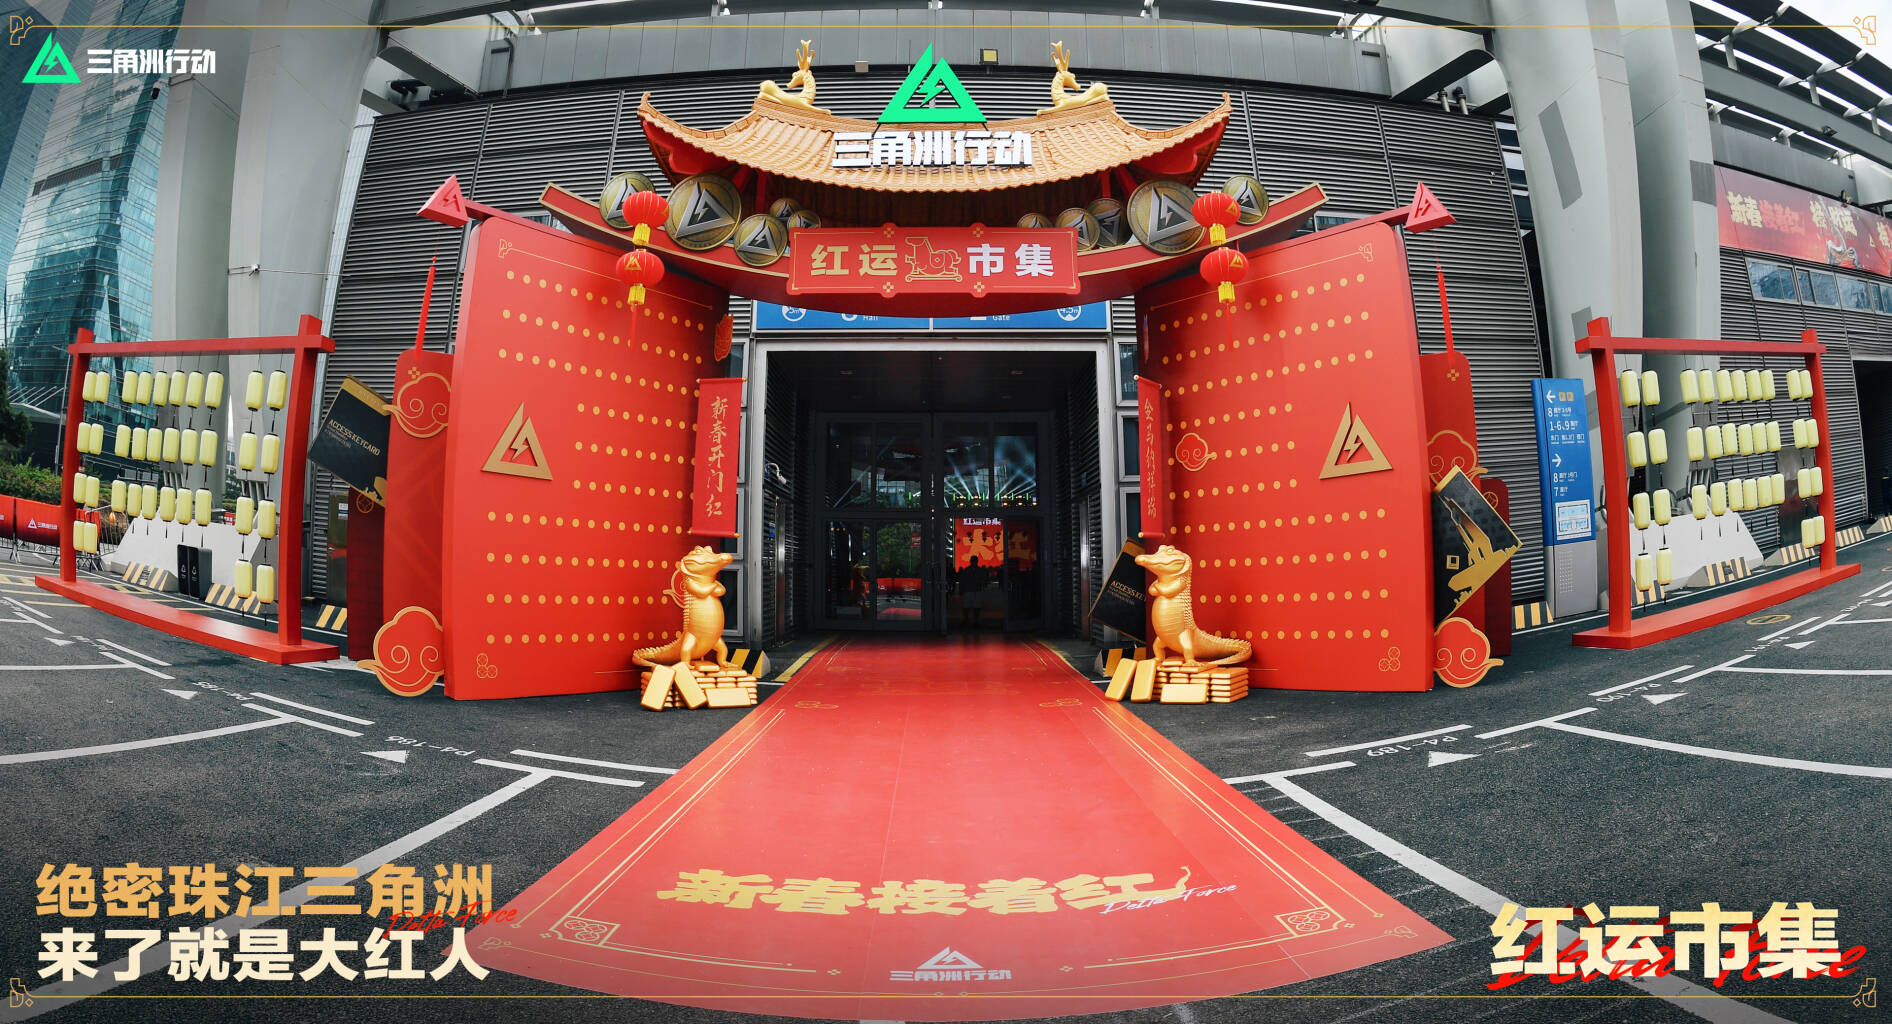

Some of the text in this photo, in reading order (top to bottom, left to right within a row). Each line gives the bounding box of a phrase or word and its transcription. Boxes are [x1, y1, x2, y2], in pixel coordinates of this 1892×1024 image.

[832, 130, 1033, 167] 三角洲行动
[810, 243, 1054, 277] 红运 市集
[705, 395, 729, 518] 新春开门红
[1366, 734, 1459, 757] P4-189
[657, 866, 1191, 916] 新春接着红
[888, 968, 1012, 981] 三角洲行动
